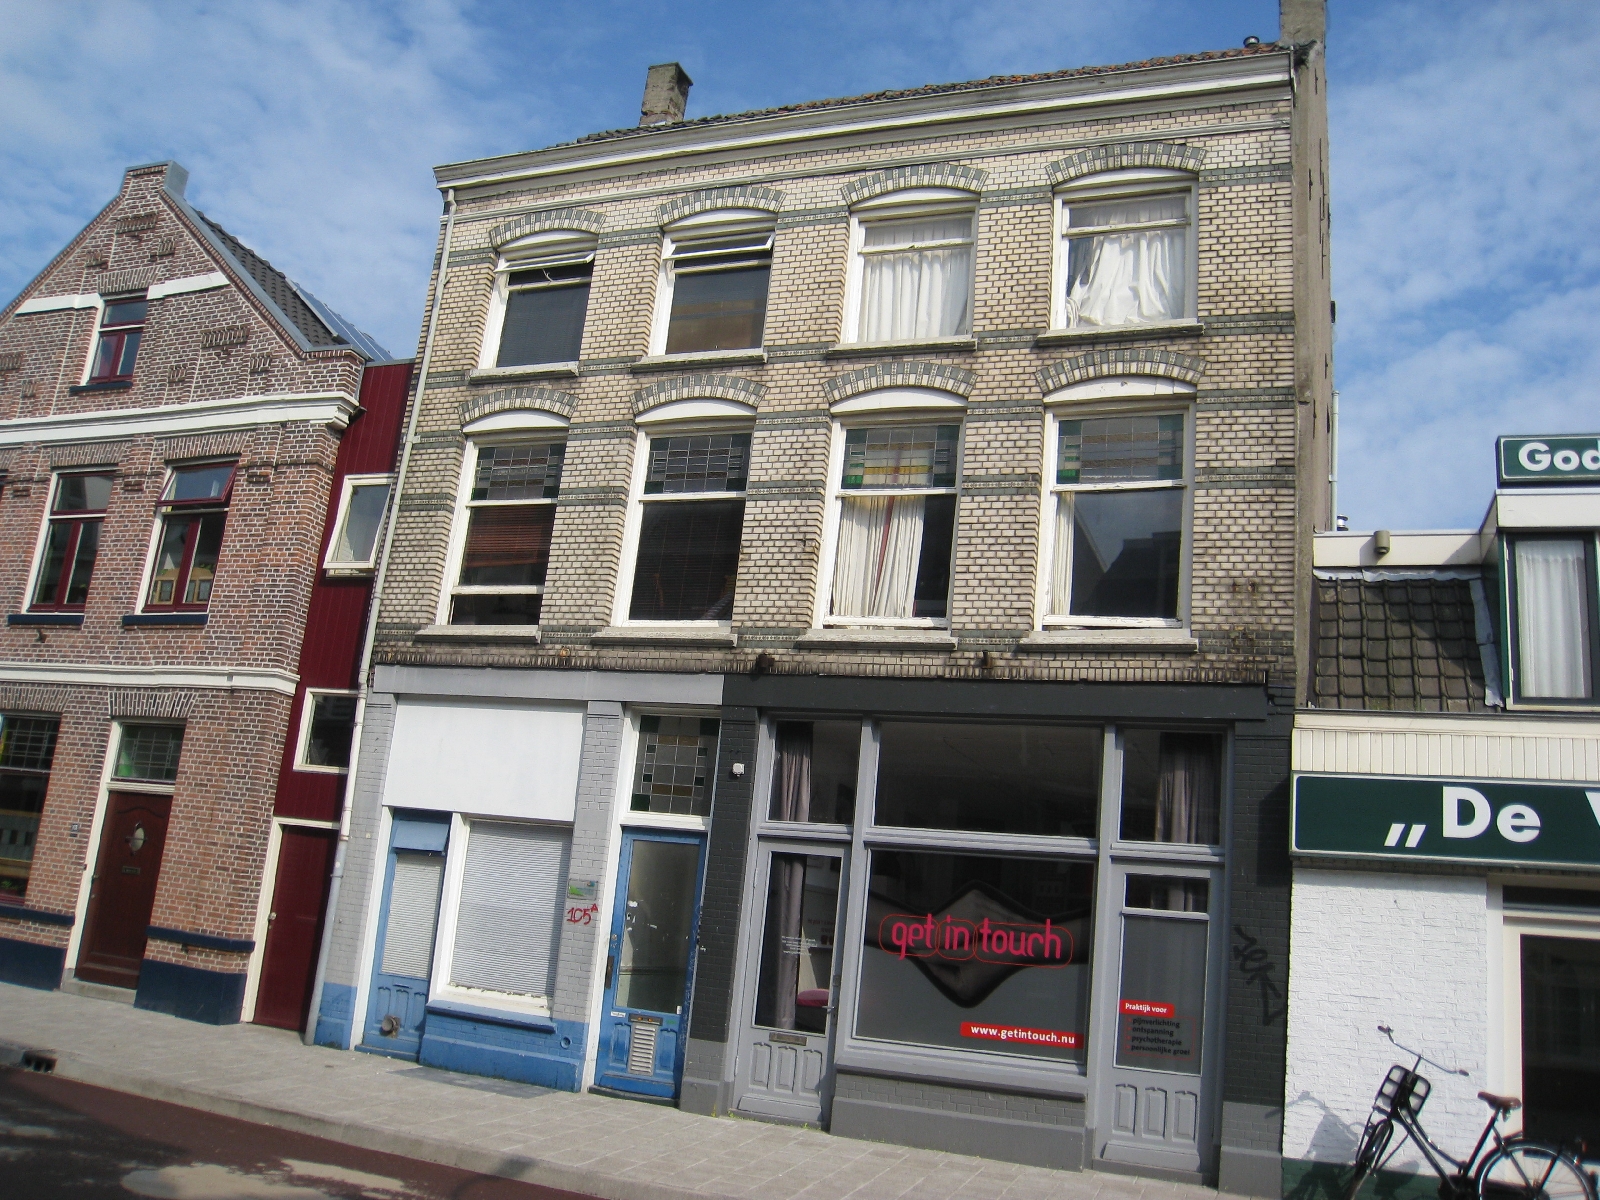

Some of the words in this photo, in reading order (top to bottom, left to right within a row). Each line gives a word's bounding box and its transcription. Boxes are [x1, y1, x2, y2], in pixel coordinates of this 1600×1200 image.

[891, 913, 934, 960] get
[944, 915, 970, 951] in
[979, 917, 1062, 959] touch
[1125, 1003, 1151, 1013] Praktijk
[1151, 1006, 1167, 1014] voor
[1132, 1017, 1181, 1029] pijnverlichting
[970, 1025, 1076, 1044] www.getintouch.nu
[1132, 1026, 1175, 1037] ontspanning
[1131, 1035, 1183, 1046] psychotherapie
[1130, 1044, 1171, 1054] persoonlijke
